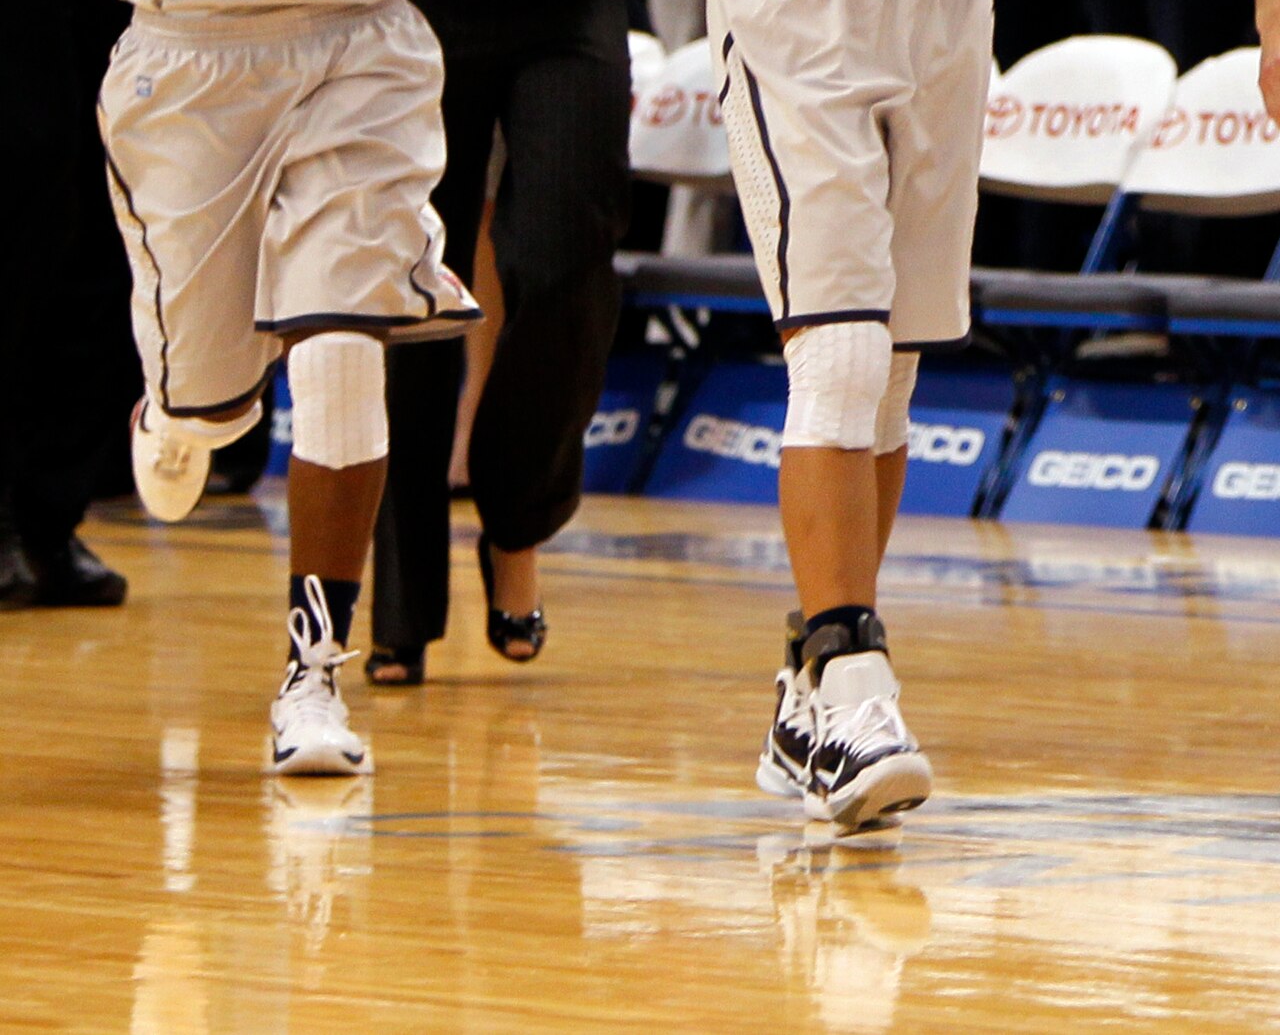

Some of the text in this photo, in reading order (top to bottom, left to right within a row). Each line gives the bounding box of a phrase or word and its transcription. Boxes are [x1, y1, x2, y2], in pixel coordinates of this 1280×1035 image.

[1029, 103, 1141, 139] TOYOTA
[683, 415, 782, 469] GEIC
[908, 422, 985, 466] EICO
[1028, 450, 1159, 490] GEICO
